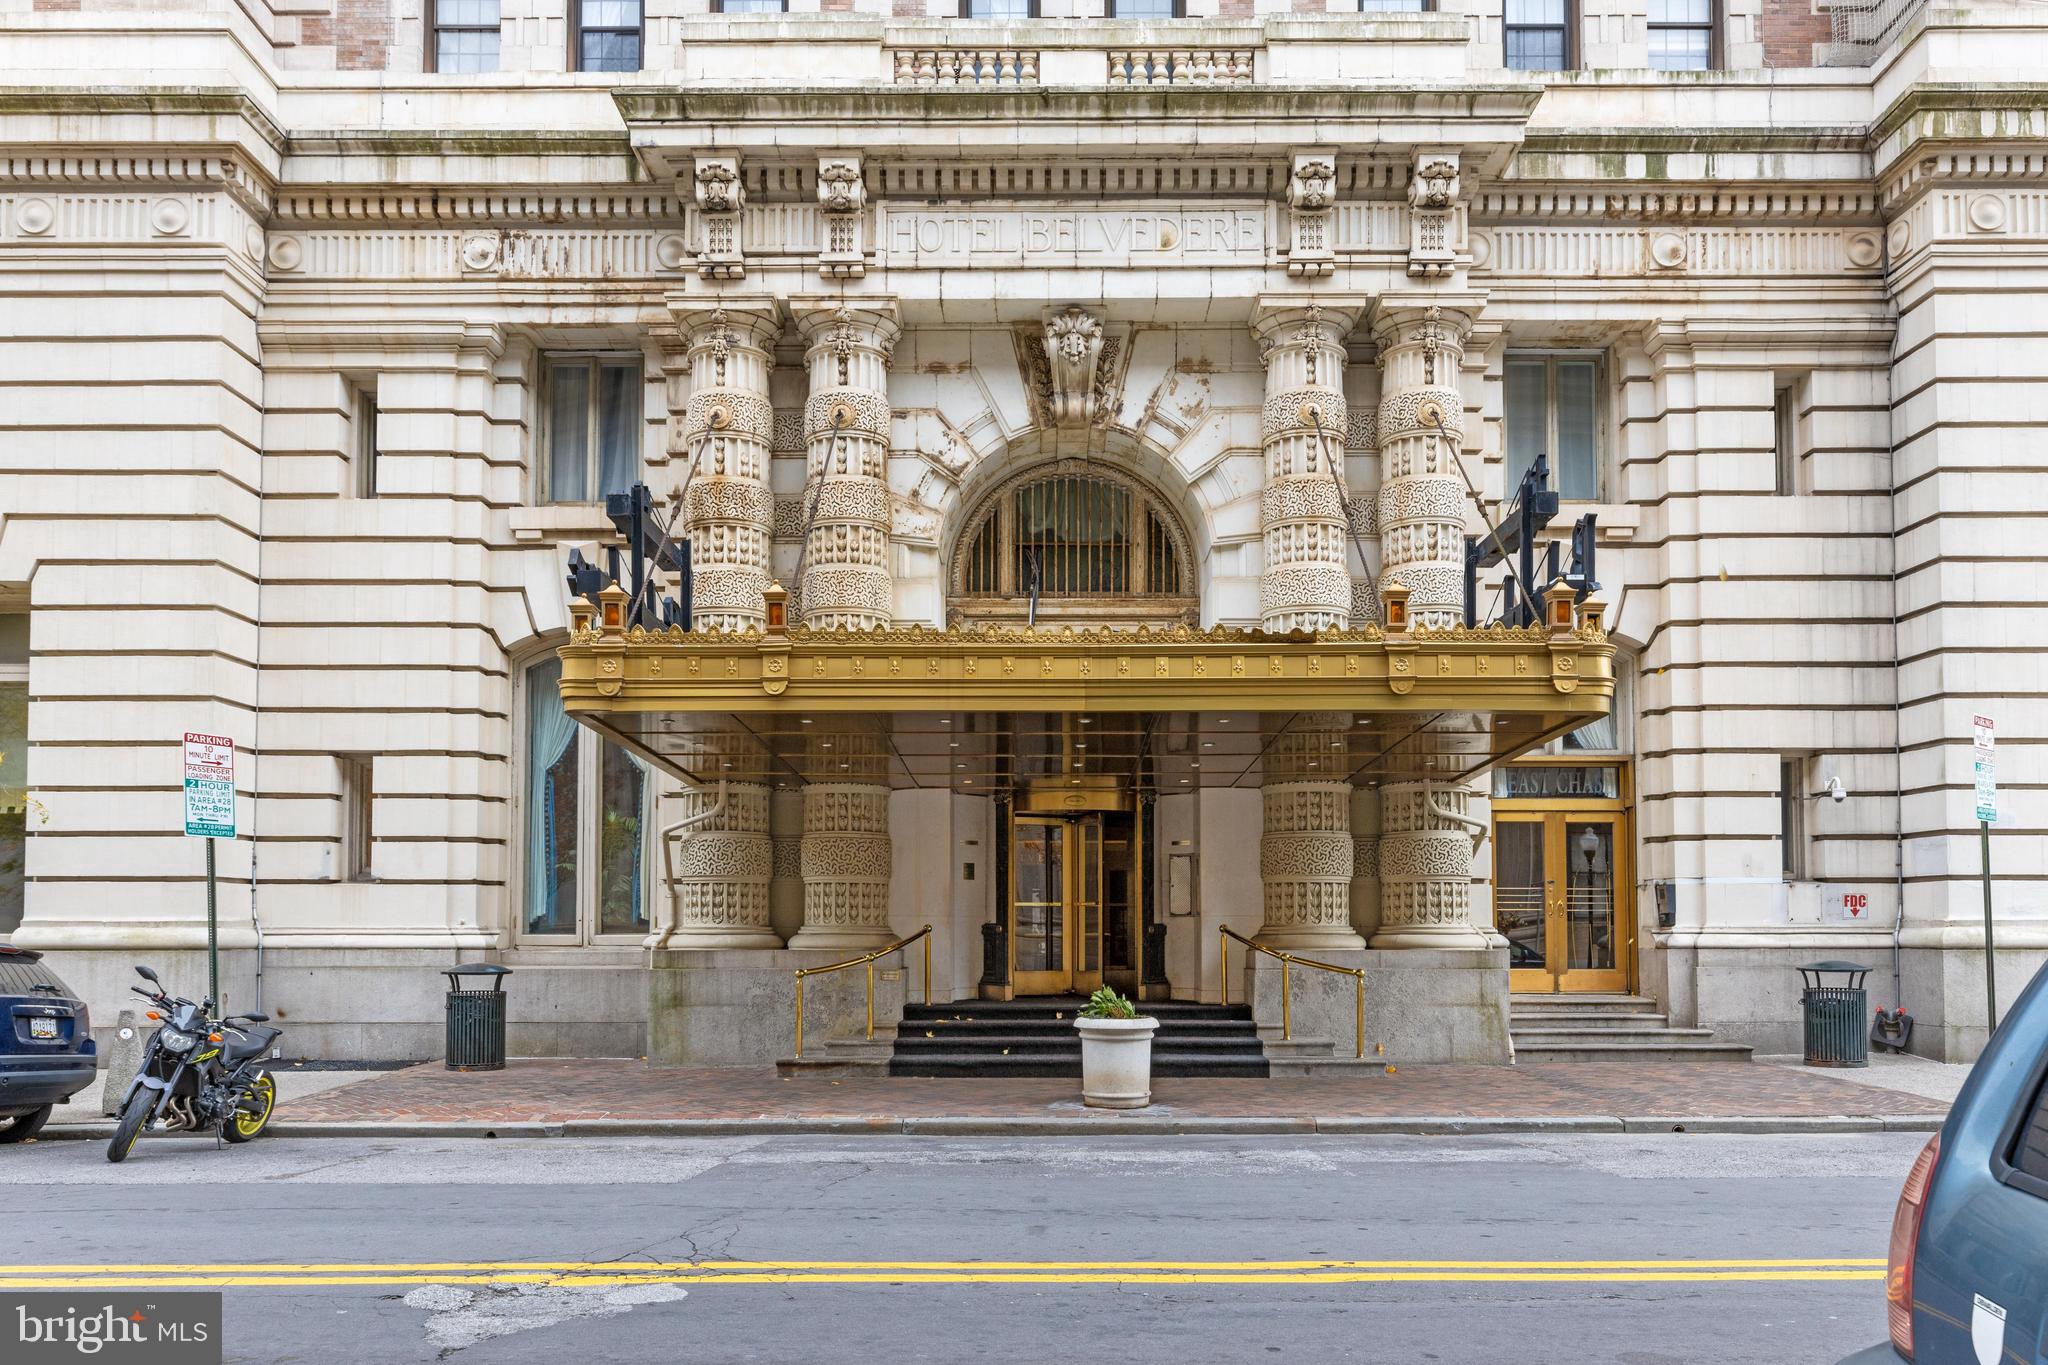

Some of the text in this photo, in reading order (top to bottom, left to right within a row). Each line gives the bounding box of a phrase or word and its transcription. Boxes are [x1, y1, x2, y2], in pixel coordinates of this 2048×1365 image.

[891, 217, 1261, 254] HOTEL BELVEDERE
[187, 733, 231, 747] PARKING
[204, 745, 214, 753] 10
[188, 751, 230, 762] MINUTE LIMIT
[187, 765, 231, 775] PASSENGER
[187, 772, 231, 782] LOADING ZONE
[189, 780, 230, 791] 2 HOUR
[1508, 772, 1615, 794] EAST CHAS
[189, 788, 214, 797] PARKING
[197, 796, 216, 804] AREA
[1843, 895, 1867, 907] FDC
